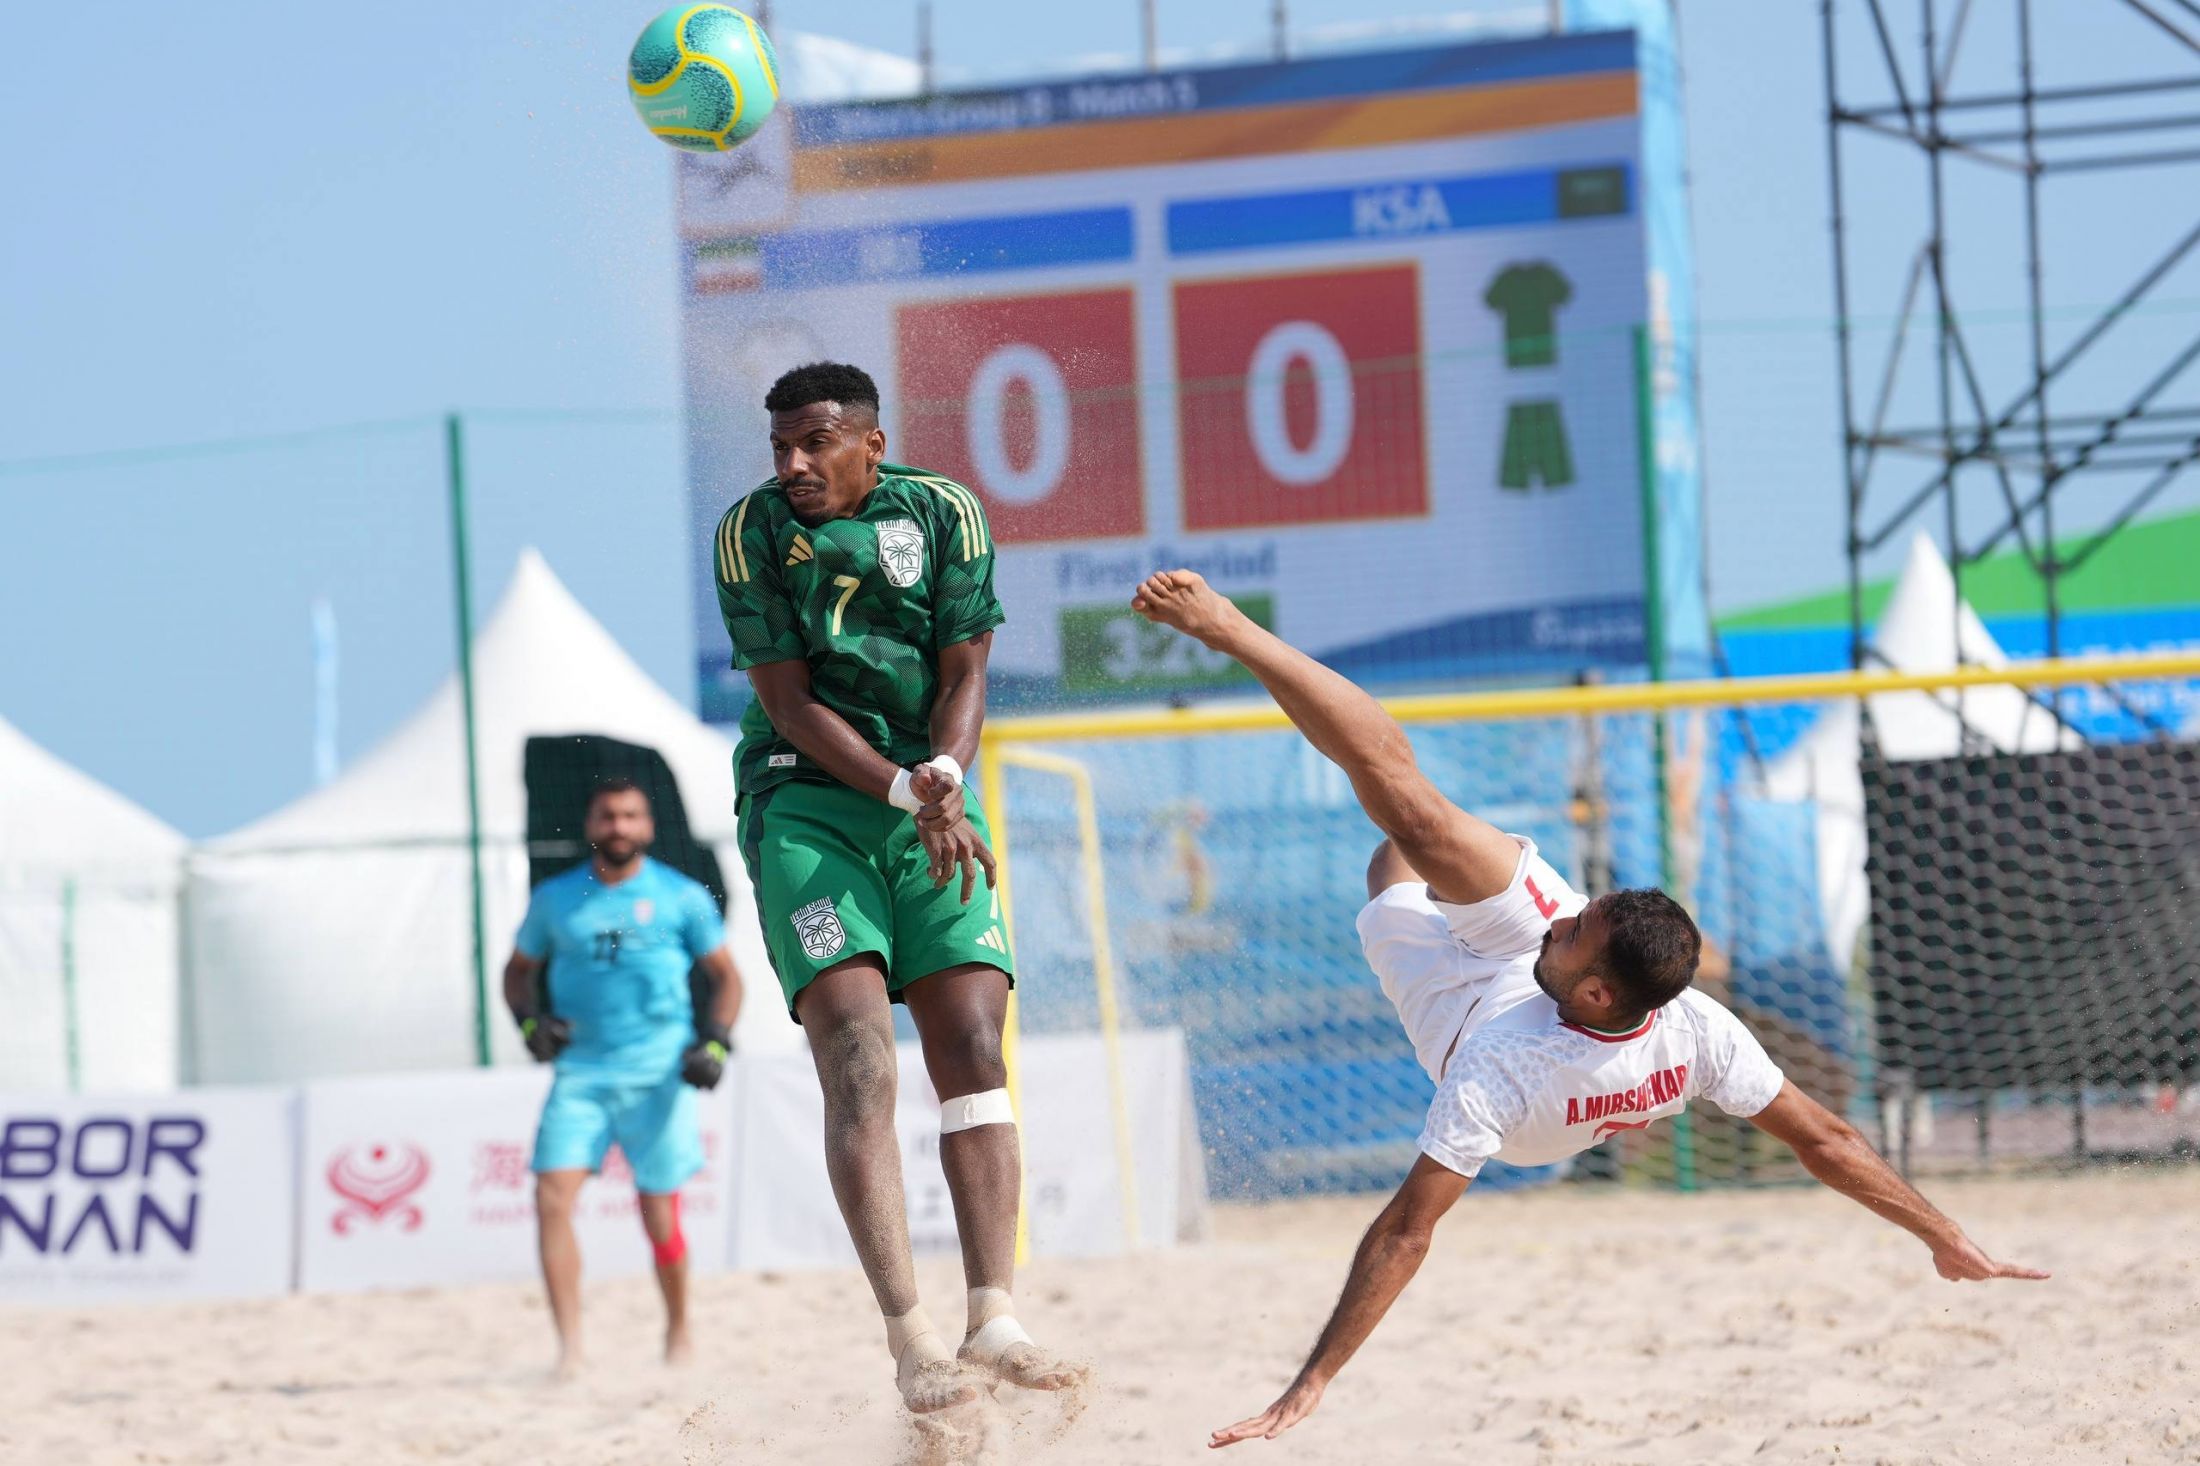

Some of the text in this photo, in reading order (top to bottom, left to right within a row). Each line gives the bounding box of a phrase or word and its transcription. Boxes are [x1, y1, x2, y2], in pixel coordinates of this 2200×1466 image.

[1353, 185, 1450, 236] KSA
[968, 344, 1071, 505] 0
[1246, 320, 1354, 484] 0
[832, 574, 861, 636] 7
[791, 904, 811, 923] TEAM
